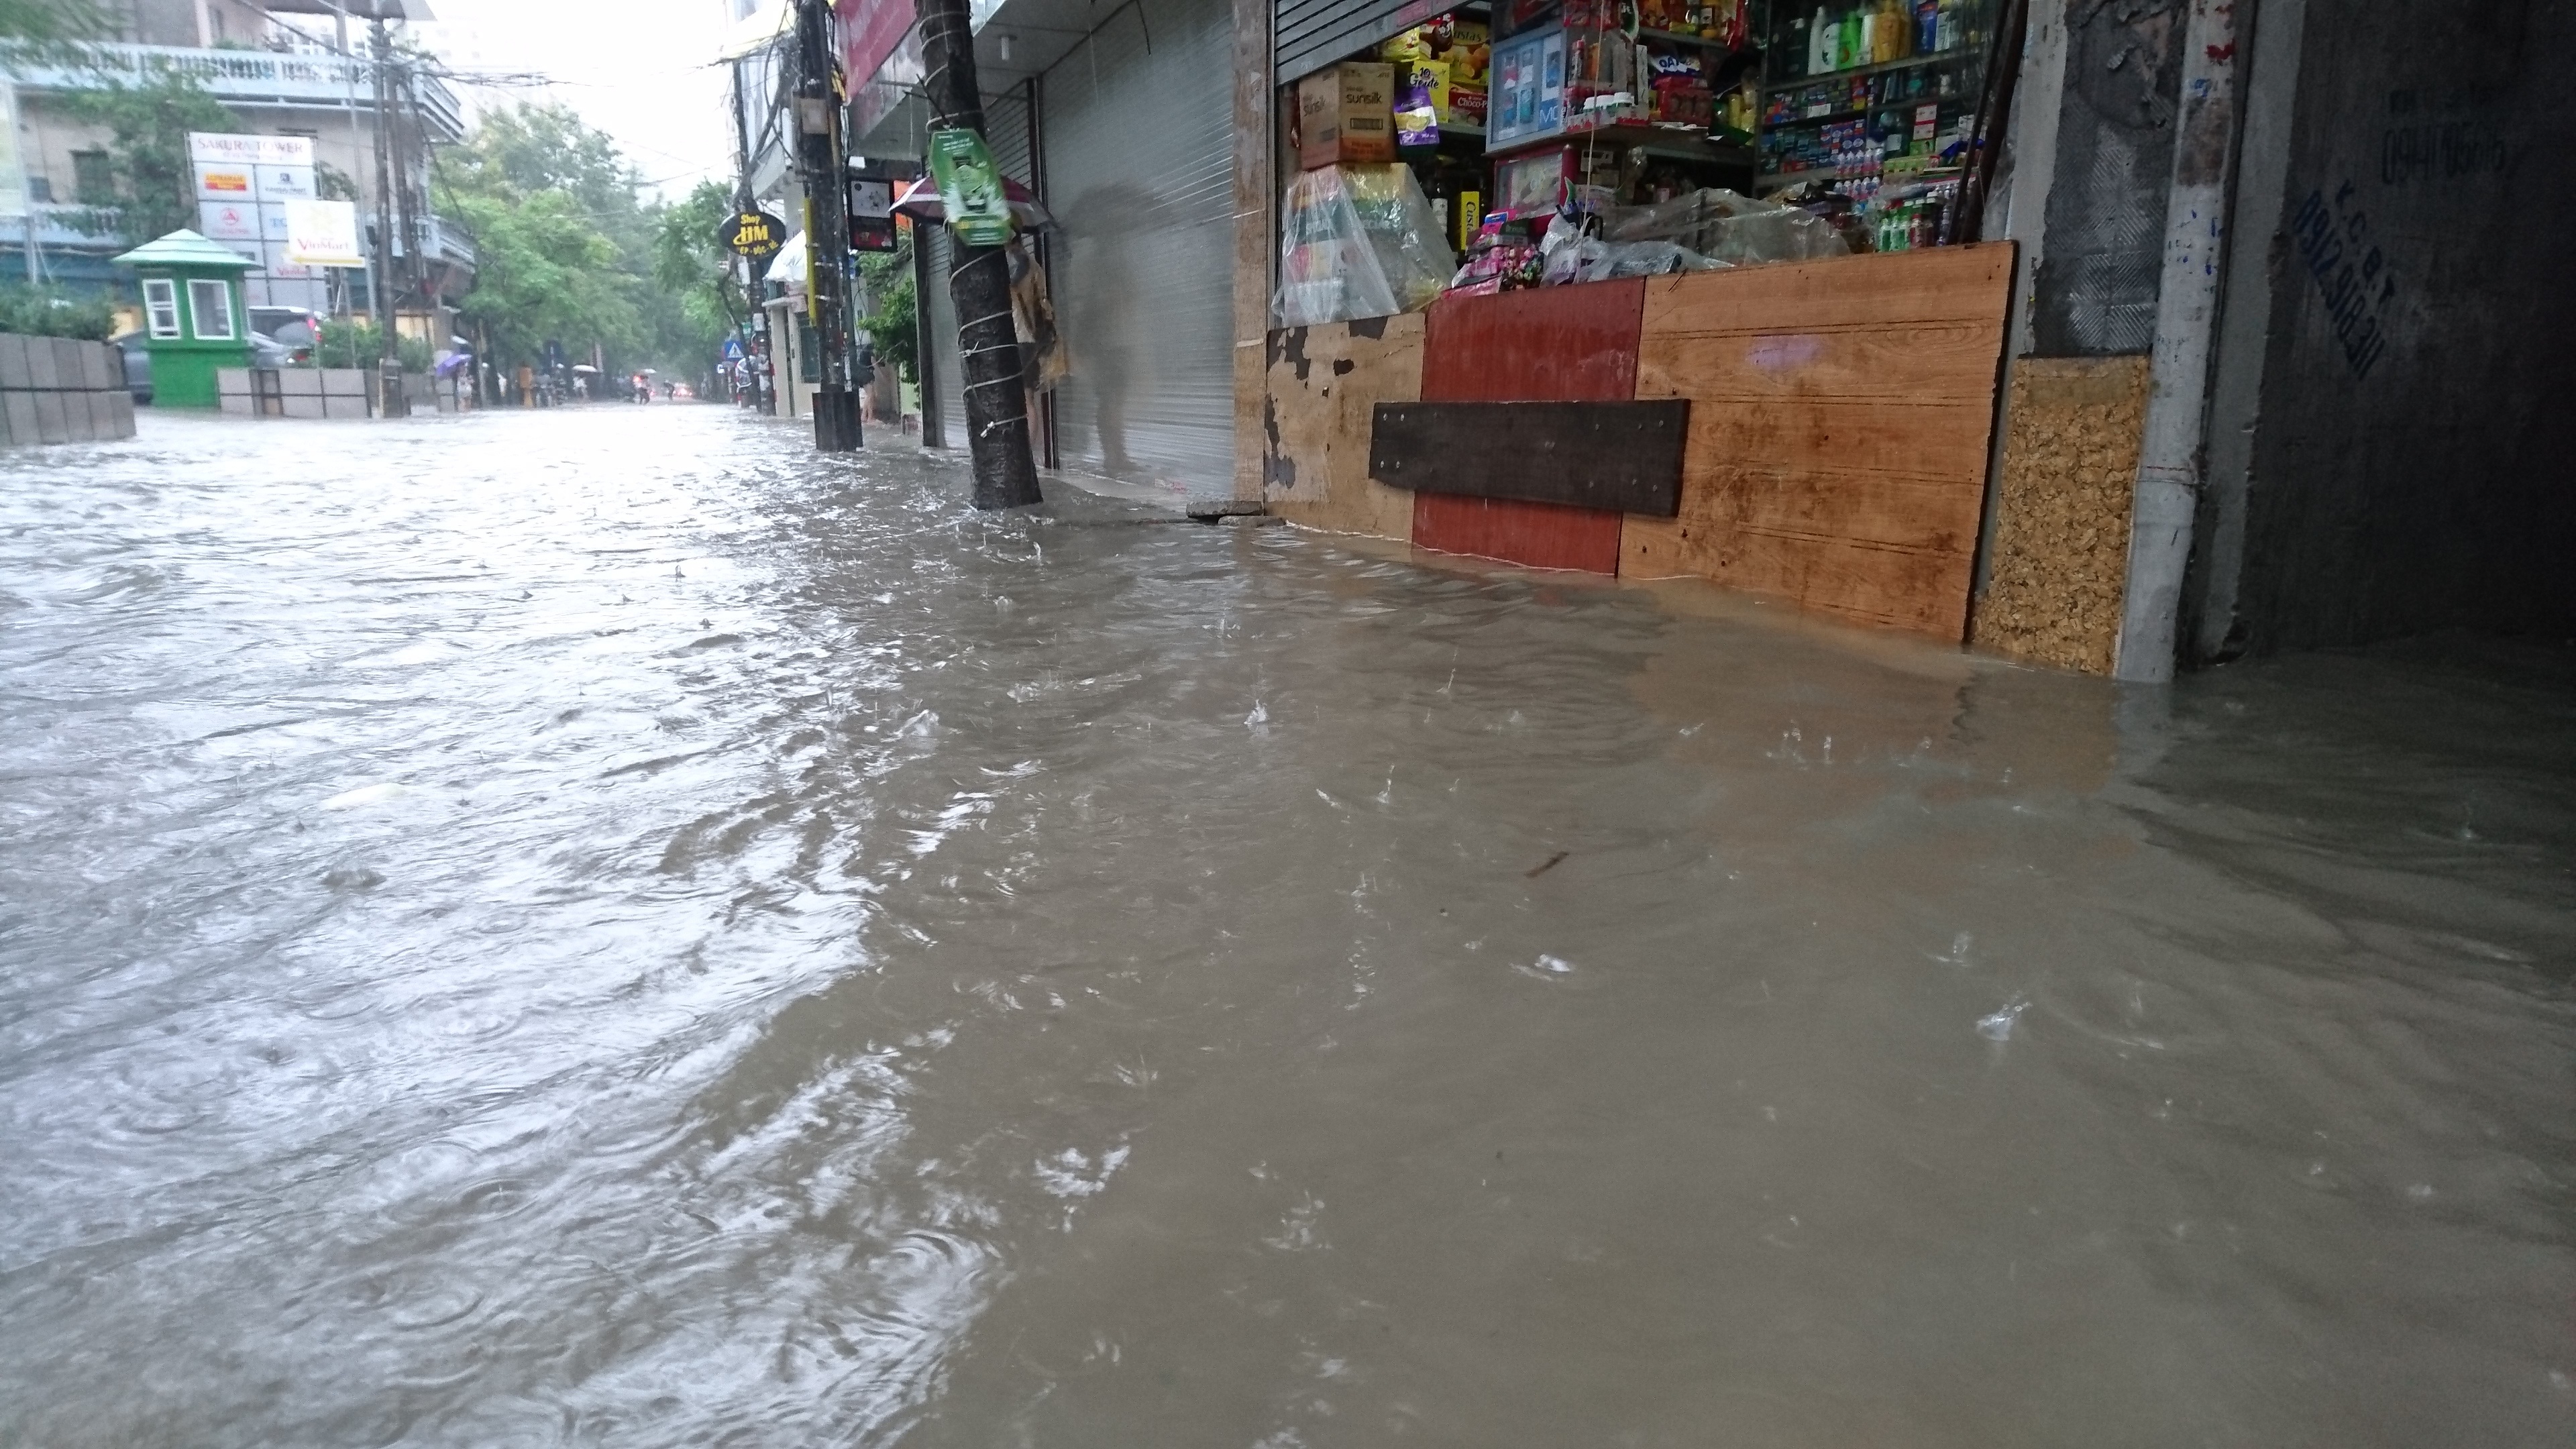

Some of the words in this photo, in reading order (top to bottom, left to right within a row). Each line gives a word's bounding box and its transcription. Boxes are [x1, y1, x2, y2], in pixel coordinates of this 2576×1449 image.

[1454, 30, 1482, 42] ustas
[1346, 91, 1382, 105] sunsilk
[297, 238, 350, 251] VinMart
